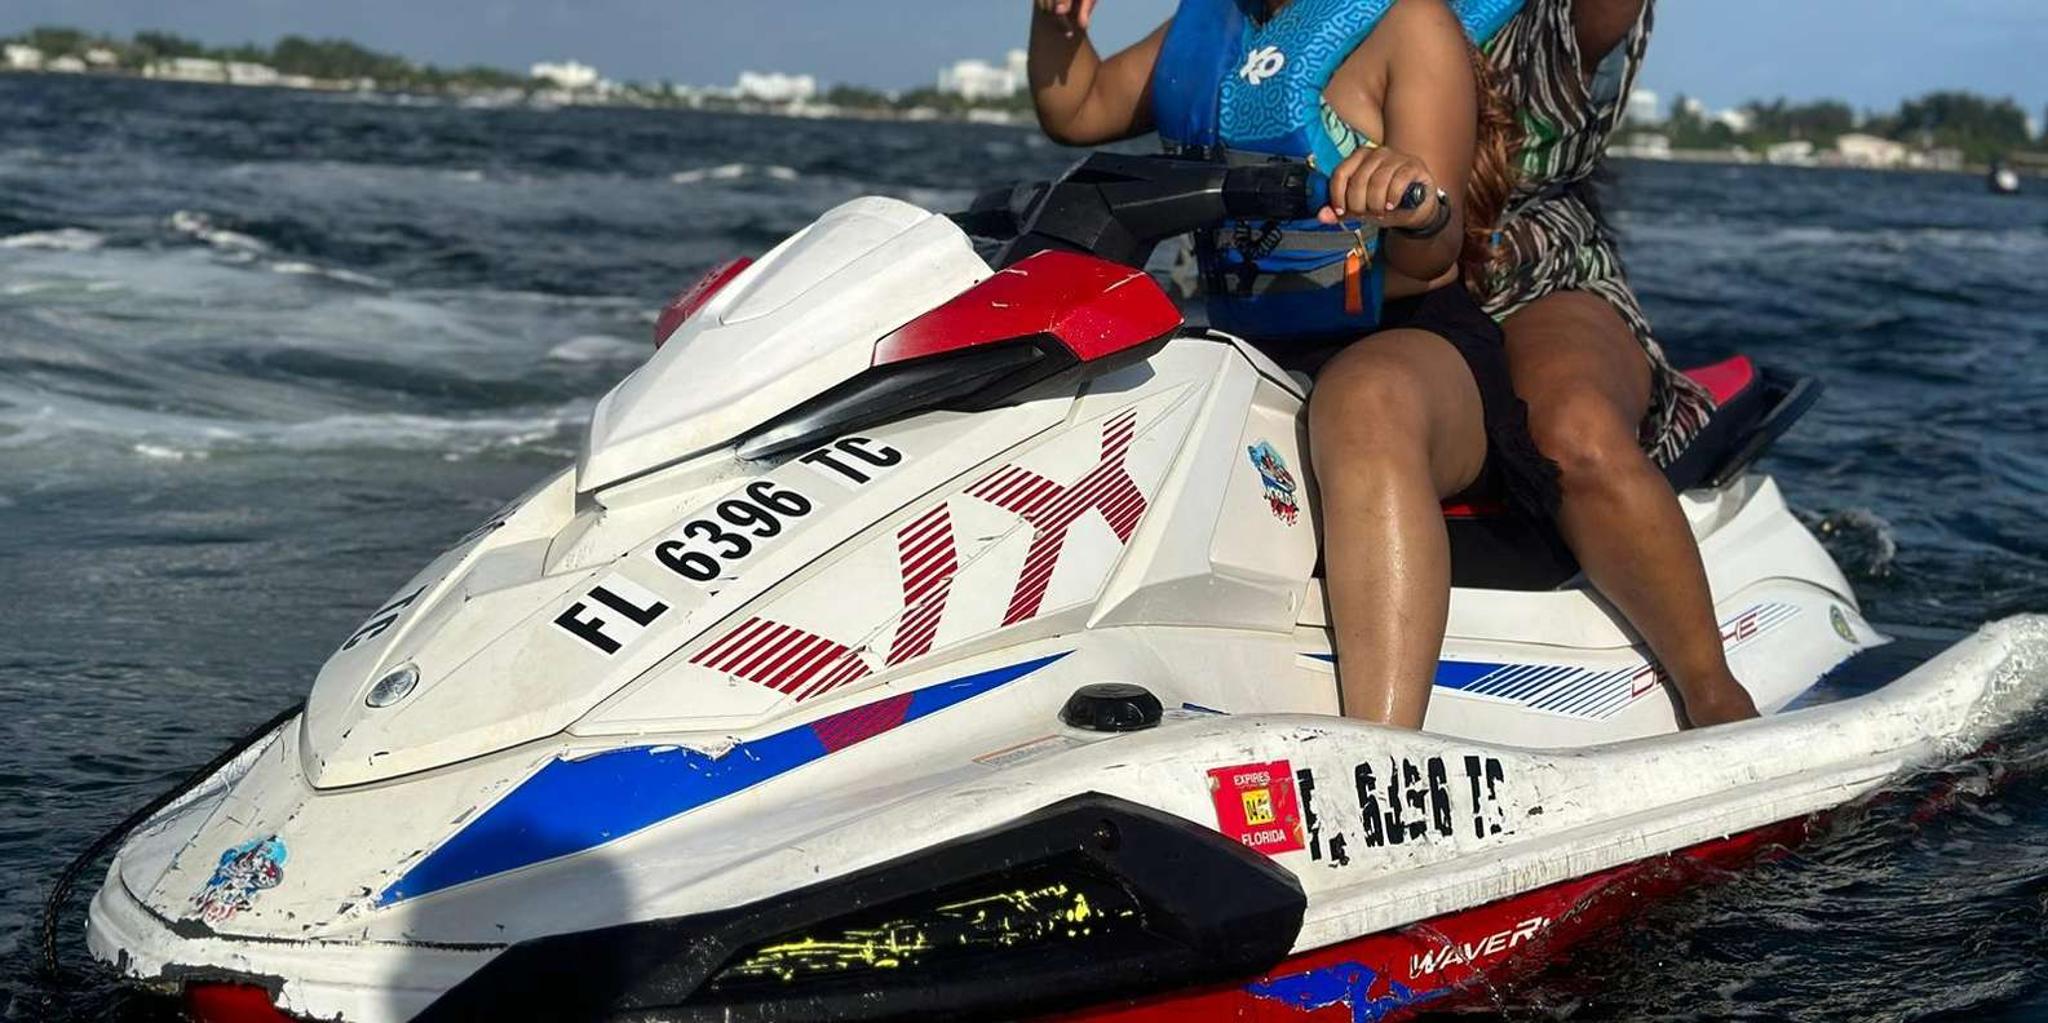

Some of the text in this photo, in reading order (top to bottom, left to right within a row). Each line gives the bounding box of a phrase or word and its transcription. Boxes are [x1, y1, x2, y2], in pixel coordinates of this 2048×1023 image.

[553, 437, 903, 655] FL 6396 TC
[1233, 771, 1271, 787] EXPIRES
[1241, 829, 1287, 847] FLORIDA
